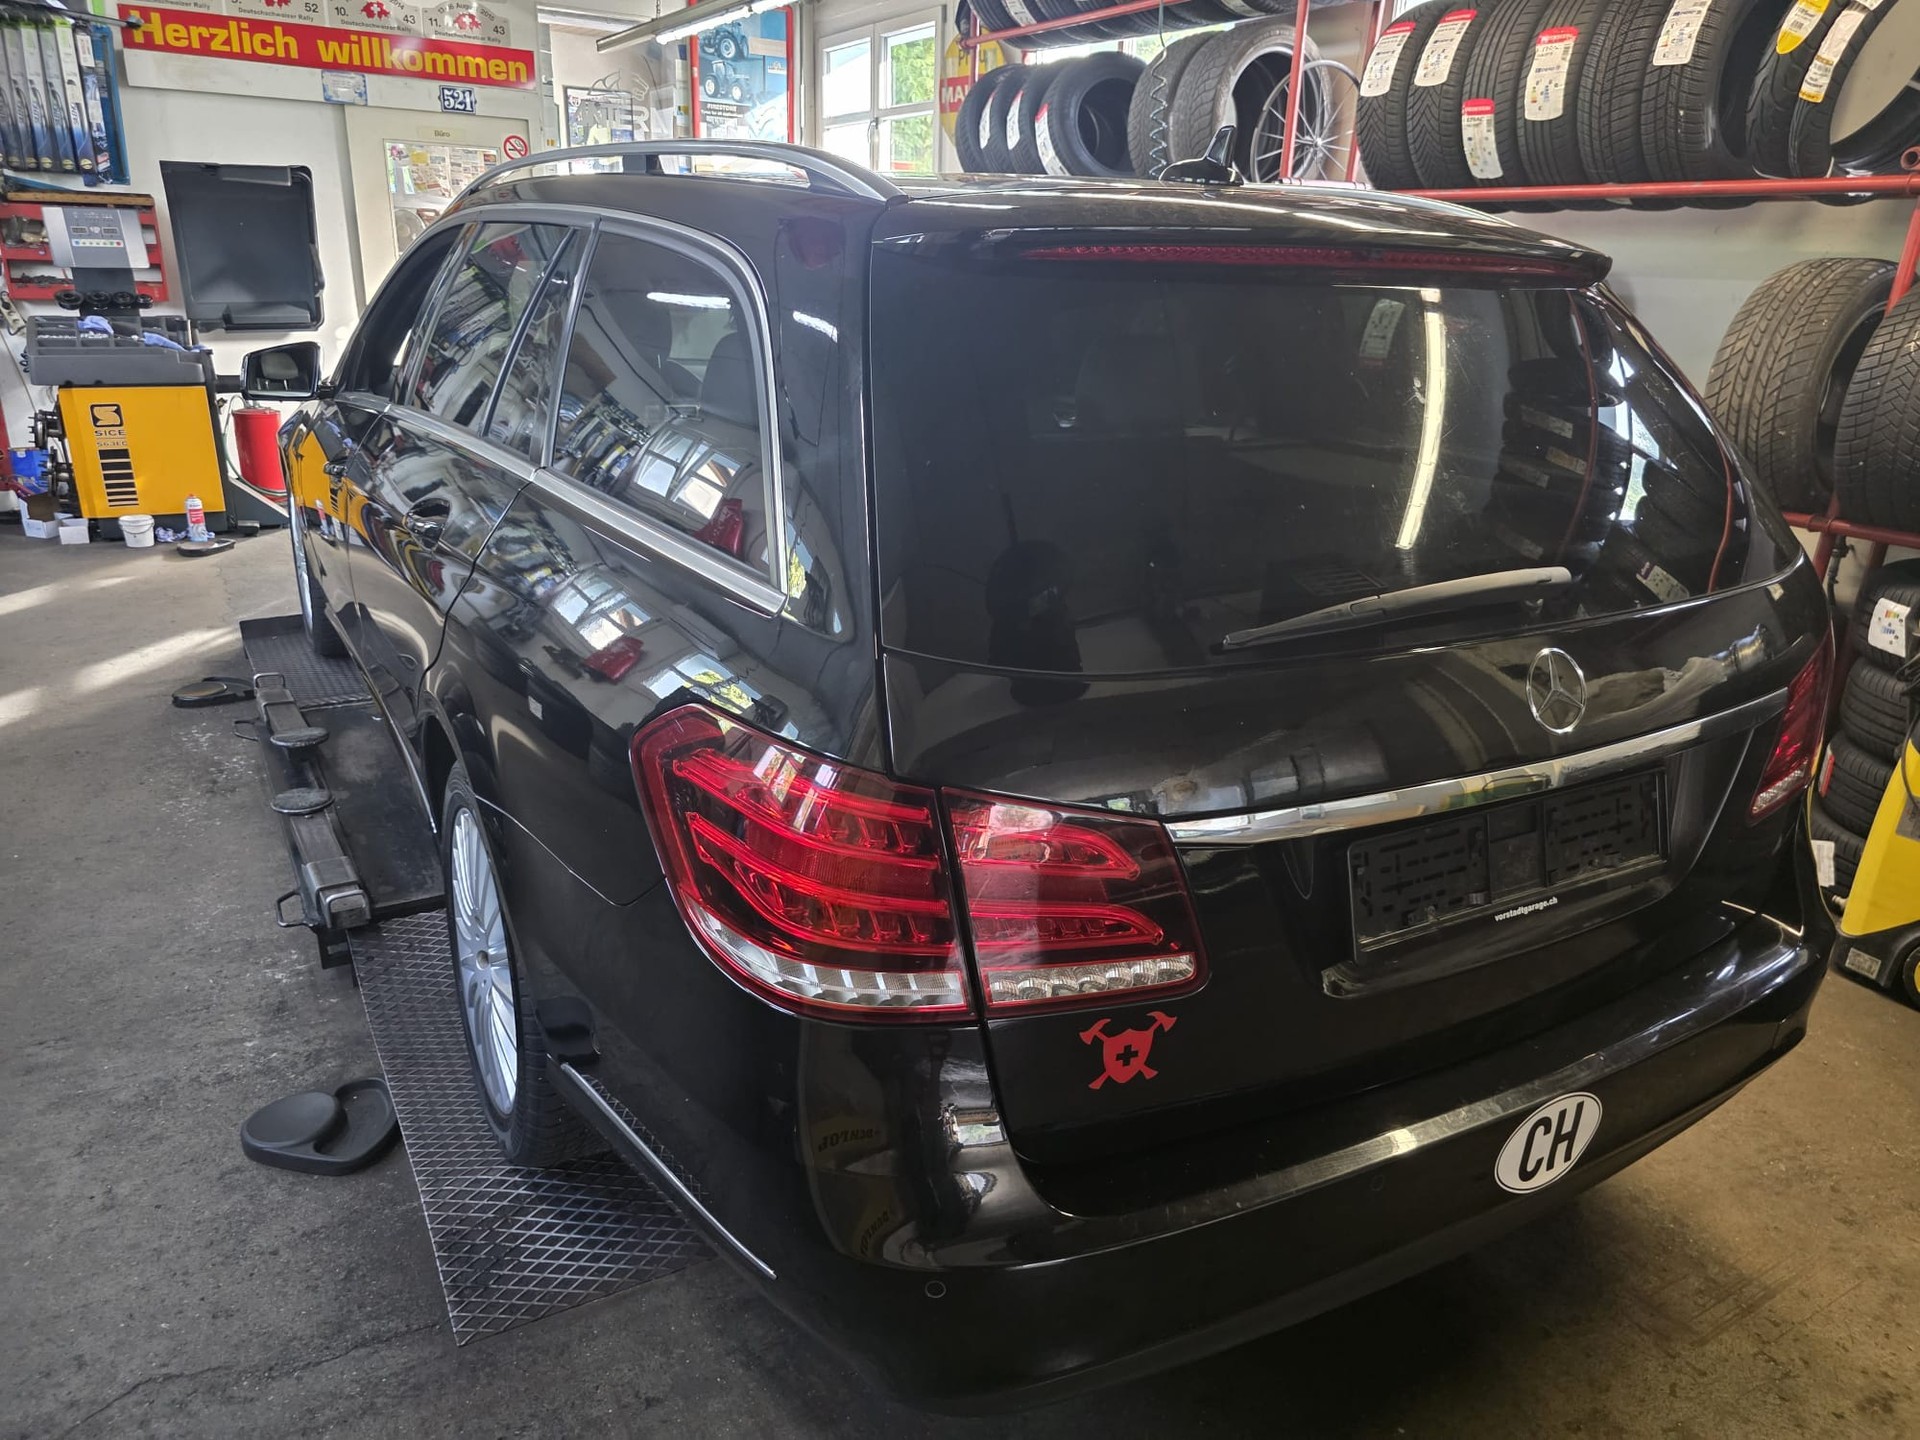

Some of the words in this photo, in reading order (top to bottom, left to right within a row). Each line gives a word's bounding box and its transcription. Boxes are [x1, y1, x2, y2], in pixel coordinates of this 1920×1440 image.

[305, 2, 319, 13] 52
[334, 6, 349, 17] 10.
[403, 14, 416, 24] 43
[428, 18, 441, 28] 11.
[493, 25, 505, 35] 43
[129, 10, 299, 59] Herzlich
[317, 35, 528, 83] willkommen
[443, 90, 473, 112] 521
[434, 129, 451, 138] Büro
[95, 429, 126, 437] SICE
[1494, 896, 1558, 921] vorstadtgarage.ch
[1518, 1100, 1584, 1182] CH
